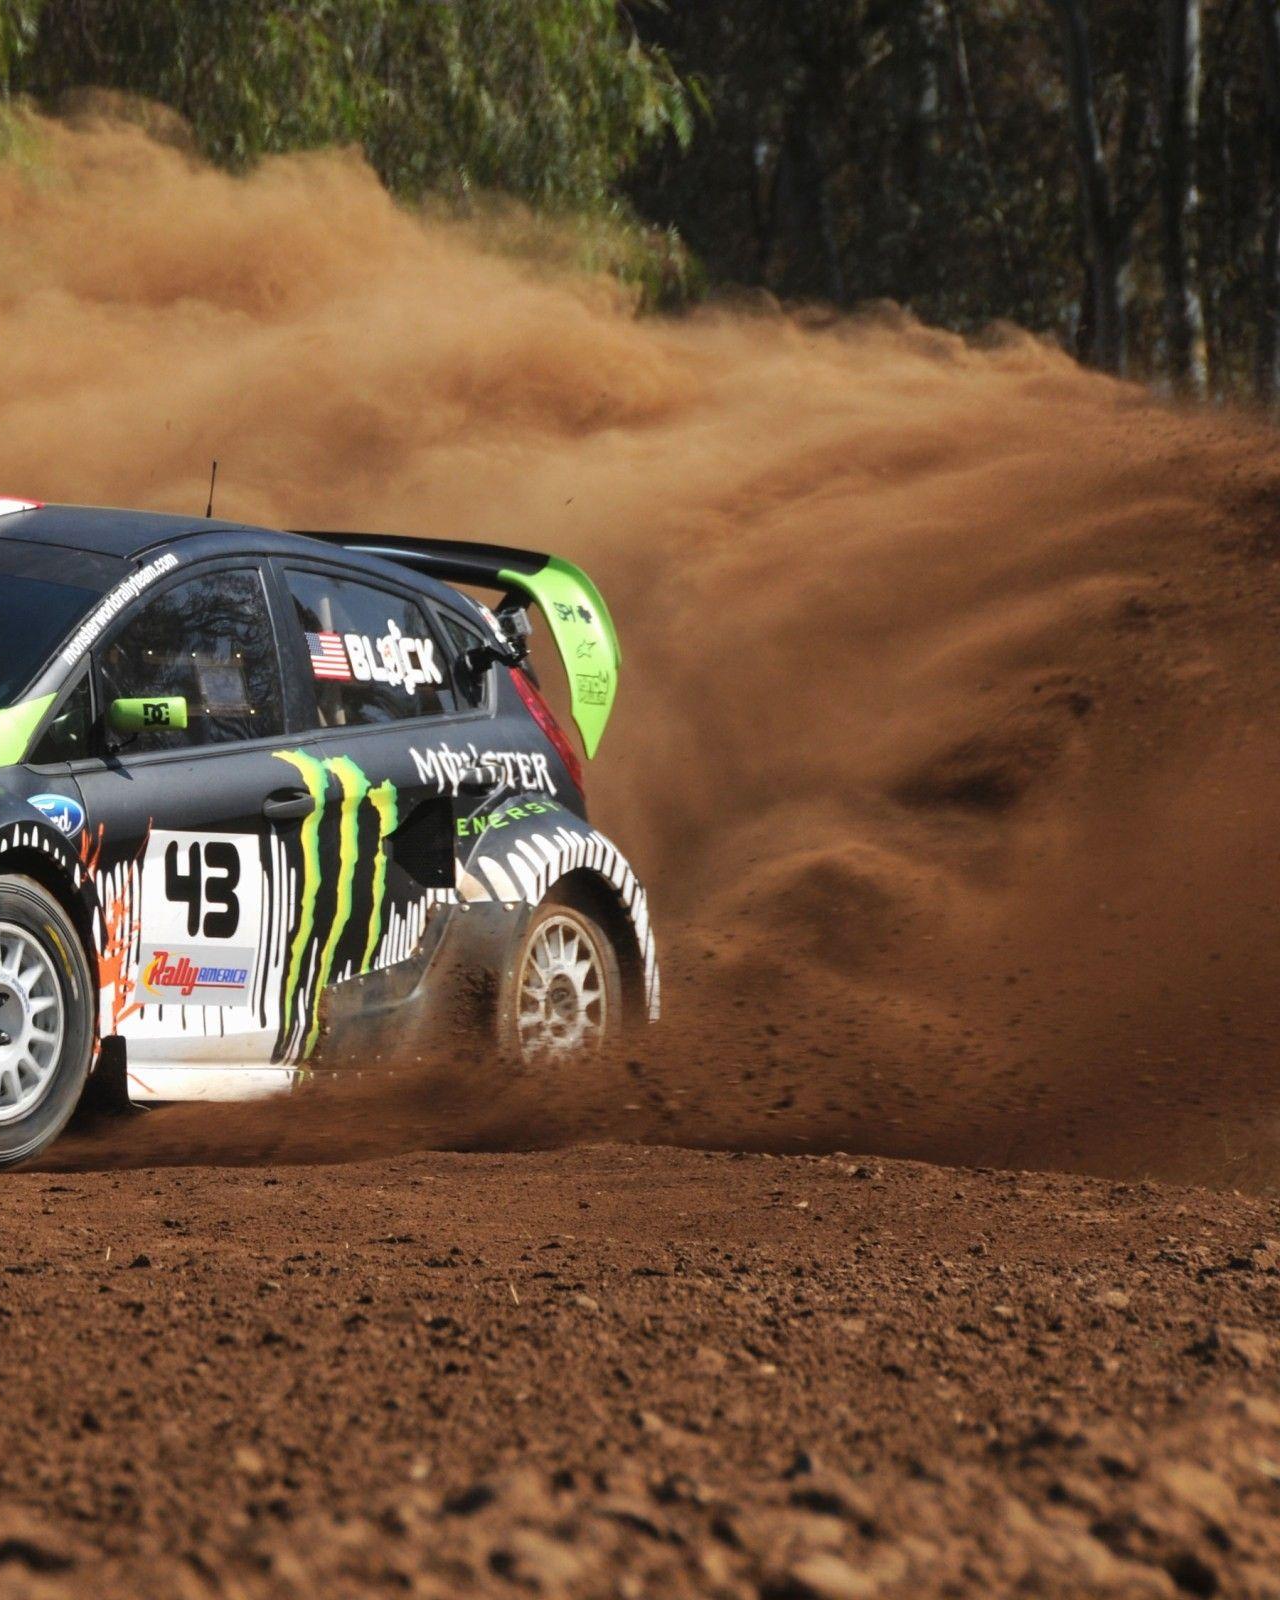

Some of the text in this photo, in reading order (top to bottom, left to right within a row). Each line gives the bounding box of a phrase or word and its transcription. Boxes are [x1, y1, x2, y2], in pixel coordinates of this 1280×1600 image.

[62, 553, 179, 665] monsterworldrallyteam.com
[344, 619, 442, 695] BLOCK
[142, 703, 170, 726] DC
[165, 840, 240, 938] 43
[149, 951, 248, 996] Rally AMERICA
